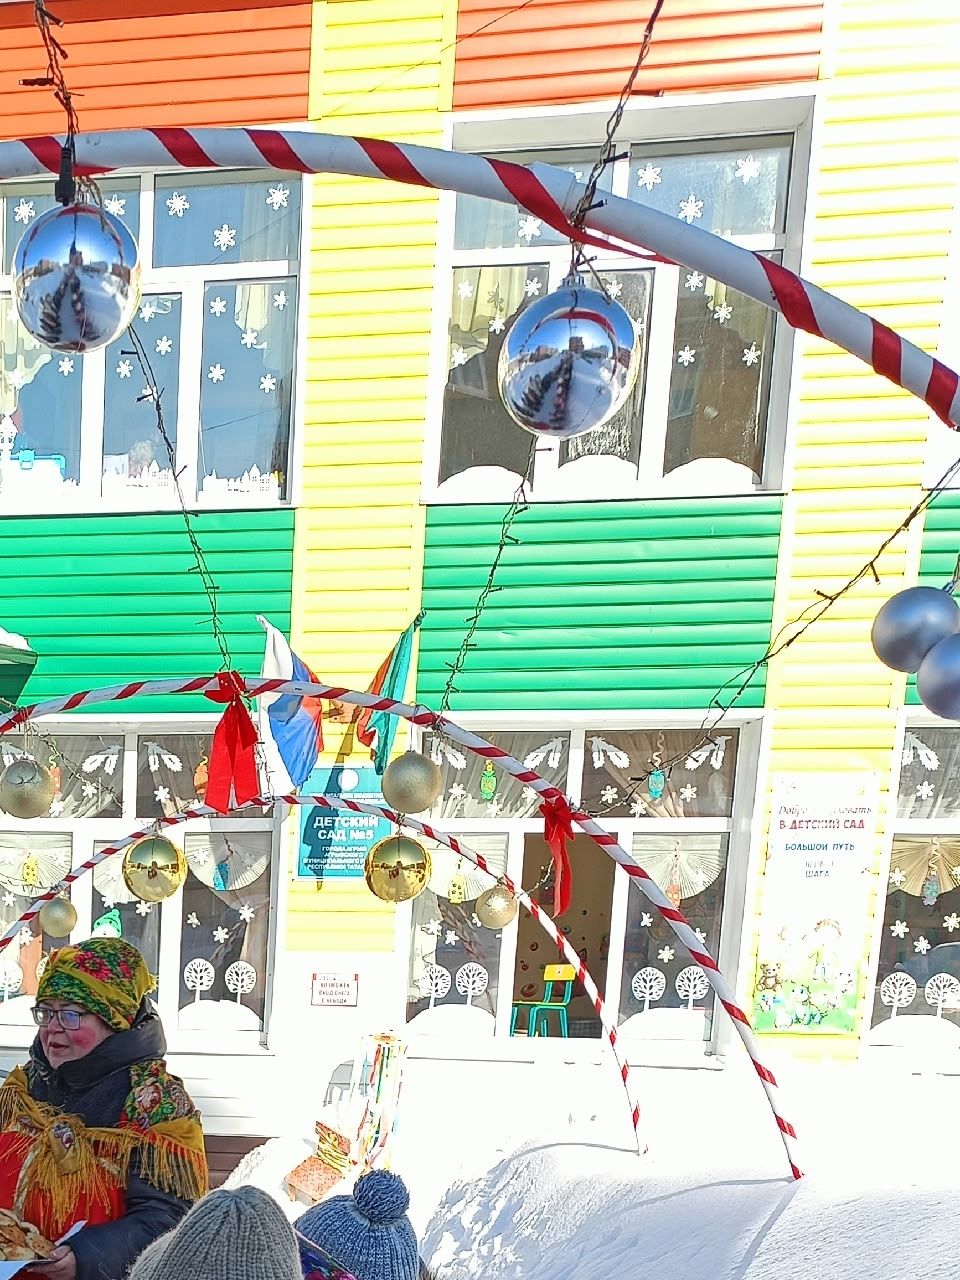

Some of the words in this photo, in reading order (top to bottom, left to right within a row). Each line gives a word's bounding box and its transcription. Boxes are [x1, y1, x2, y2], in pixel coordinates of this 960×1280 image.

[313, 815, 379, 829] ДЕТСКИЙ
[843, 820, 865, 829] САД
[317, 830, 347, 842] САД
[832, 843, 855, 851] ПУТЬ
